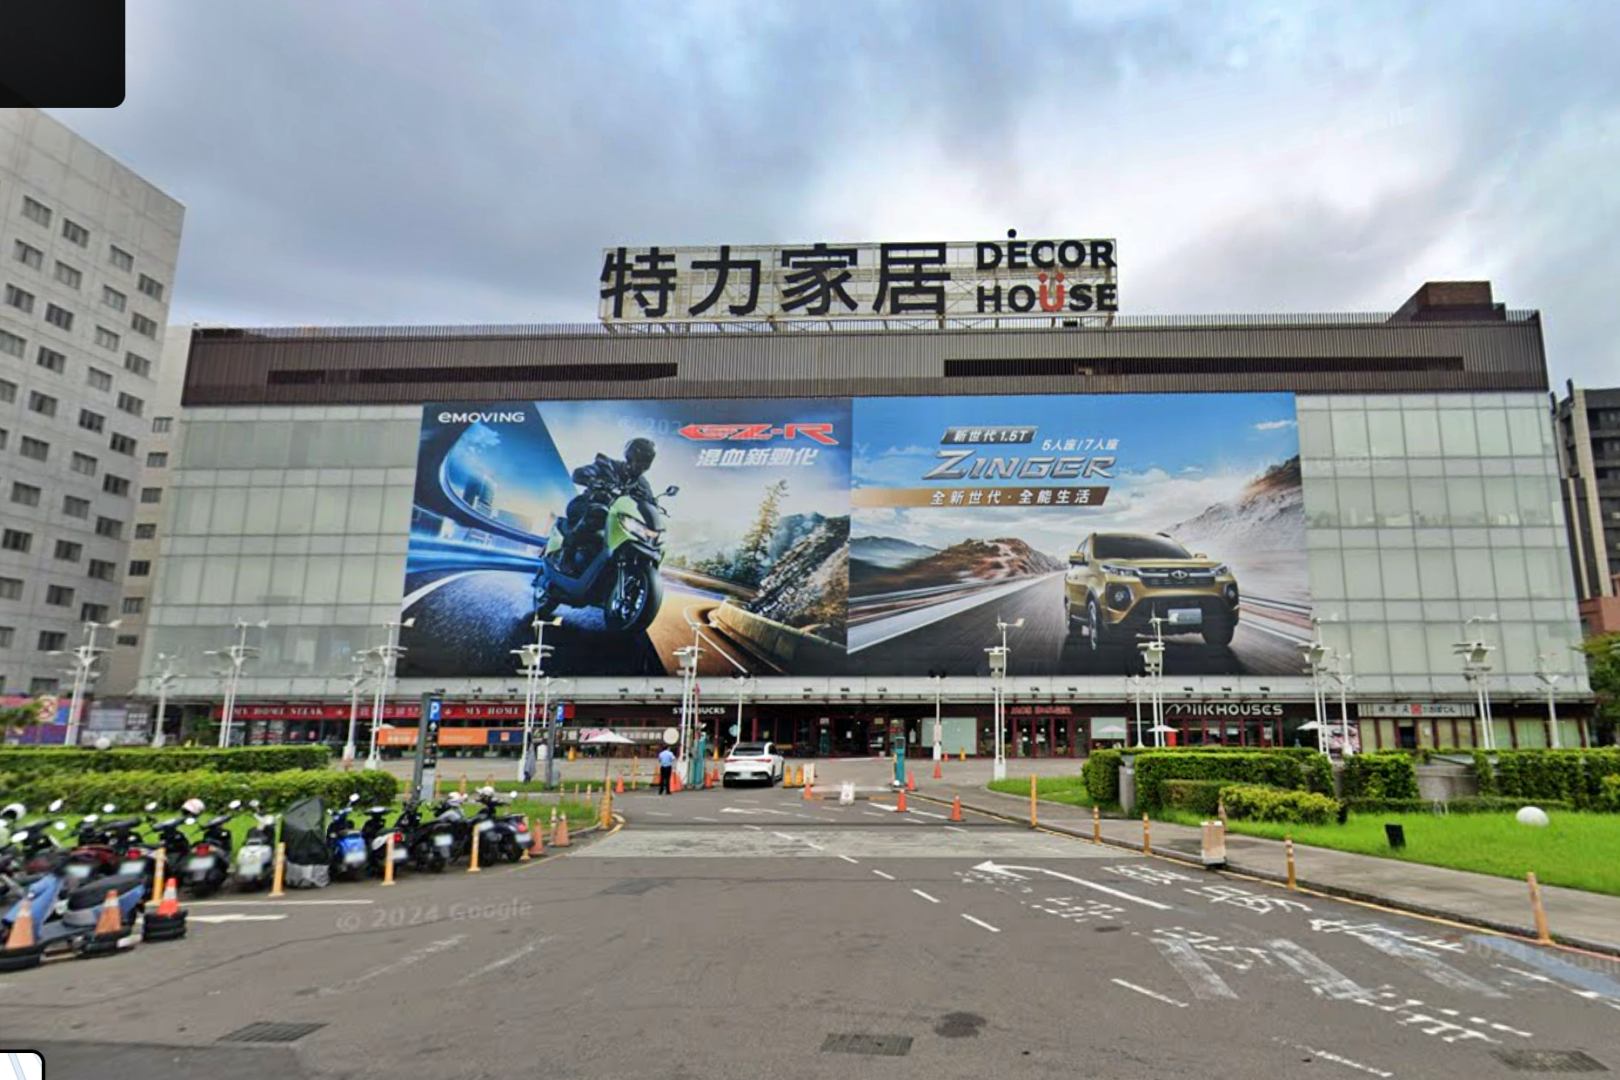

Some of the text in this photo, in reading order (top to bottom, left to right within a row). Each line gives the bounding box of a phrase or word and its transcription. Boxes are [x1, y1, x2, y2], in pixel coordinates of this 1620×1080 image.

[600, 242, 951, 318] 特力家居
[922, 449, 1117, 480] ZINGER
[430, 701, 440, 720] P
